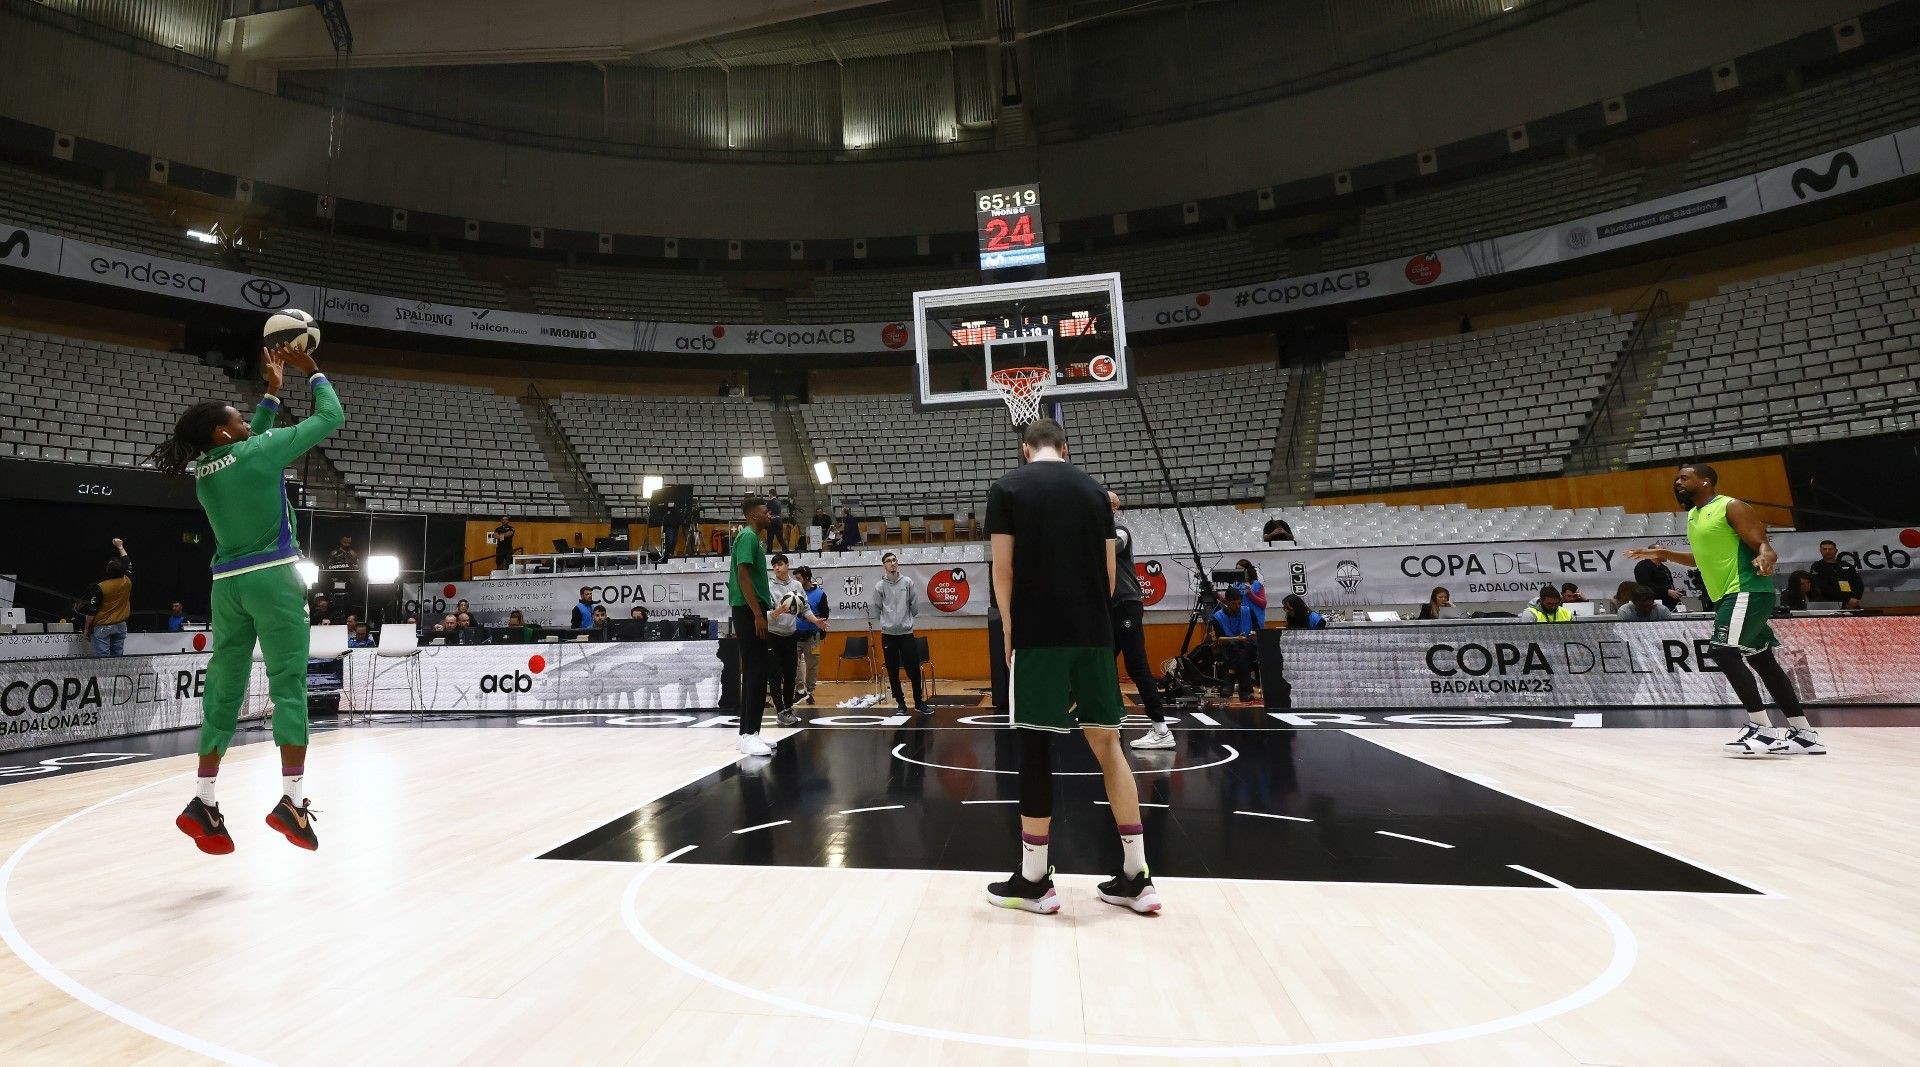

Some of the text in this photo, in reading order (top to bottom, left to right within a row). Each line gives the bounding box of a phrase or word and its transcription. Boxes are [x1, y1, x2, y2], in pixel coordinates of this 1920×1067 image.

[979, 190, 1036, 211] 65:19
[986, 215, 1035, 251] 24
[1604, 218, 1658, 234] Ajuntament
[91, 257, 206, 293] endesa
[1234, 270, 1371, 308] #CopaACB
[325, 298, 369, 313] divina
[1155, 306, 1201, 325] acb
[395, 307, 453, 327] SPALDING
[471, 320, 509, 333] Halcón
[550, 328, 596, 340] MONDO
[675, 334, 715, 351] acb
[746, 328, 856, 347] #CopaACB
[1400, 549, 1615, 577] COPA DEL REY
[590, 582, 729, 604] COPA DEL RE
[839, 601, 868, 611] BARÇA
[1426, 639, 1721, 677] COPA DEL RE
[480, 669, 532, 694] acb
[1430, 679, 1553, 694] BADALONA'23
[0, 669, 206, 717] COPA DEL RE
